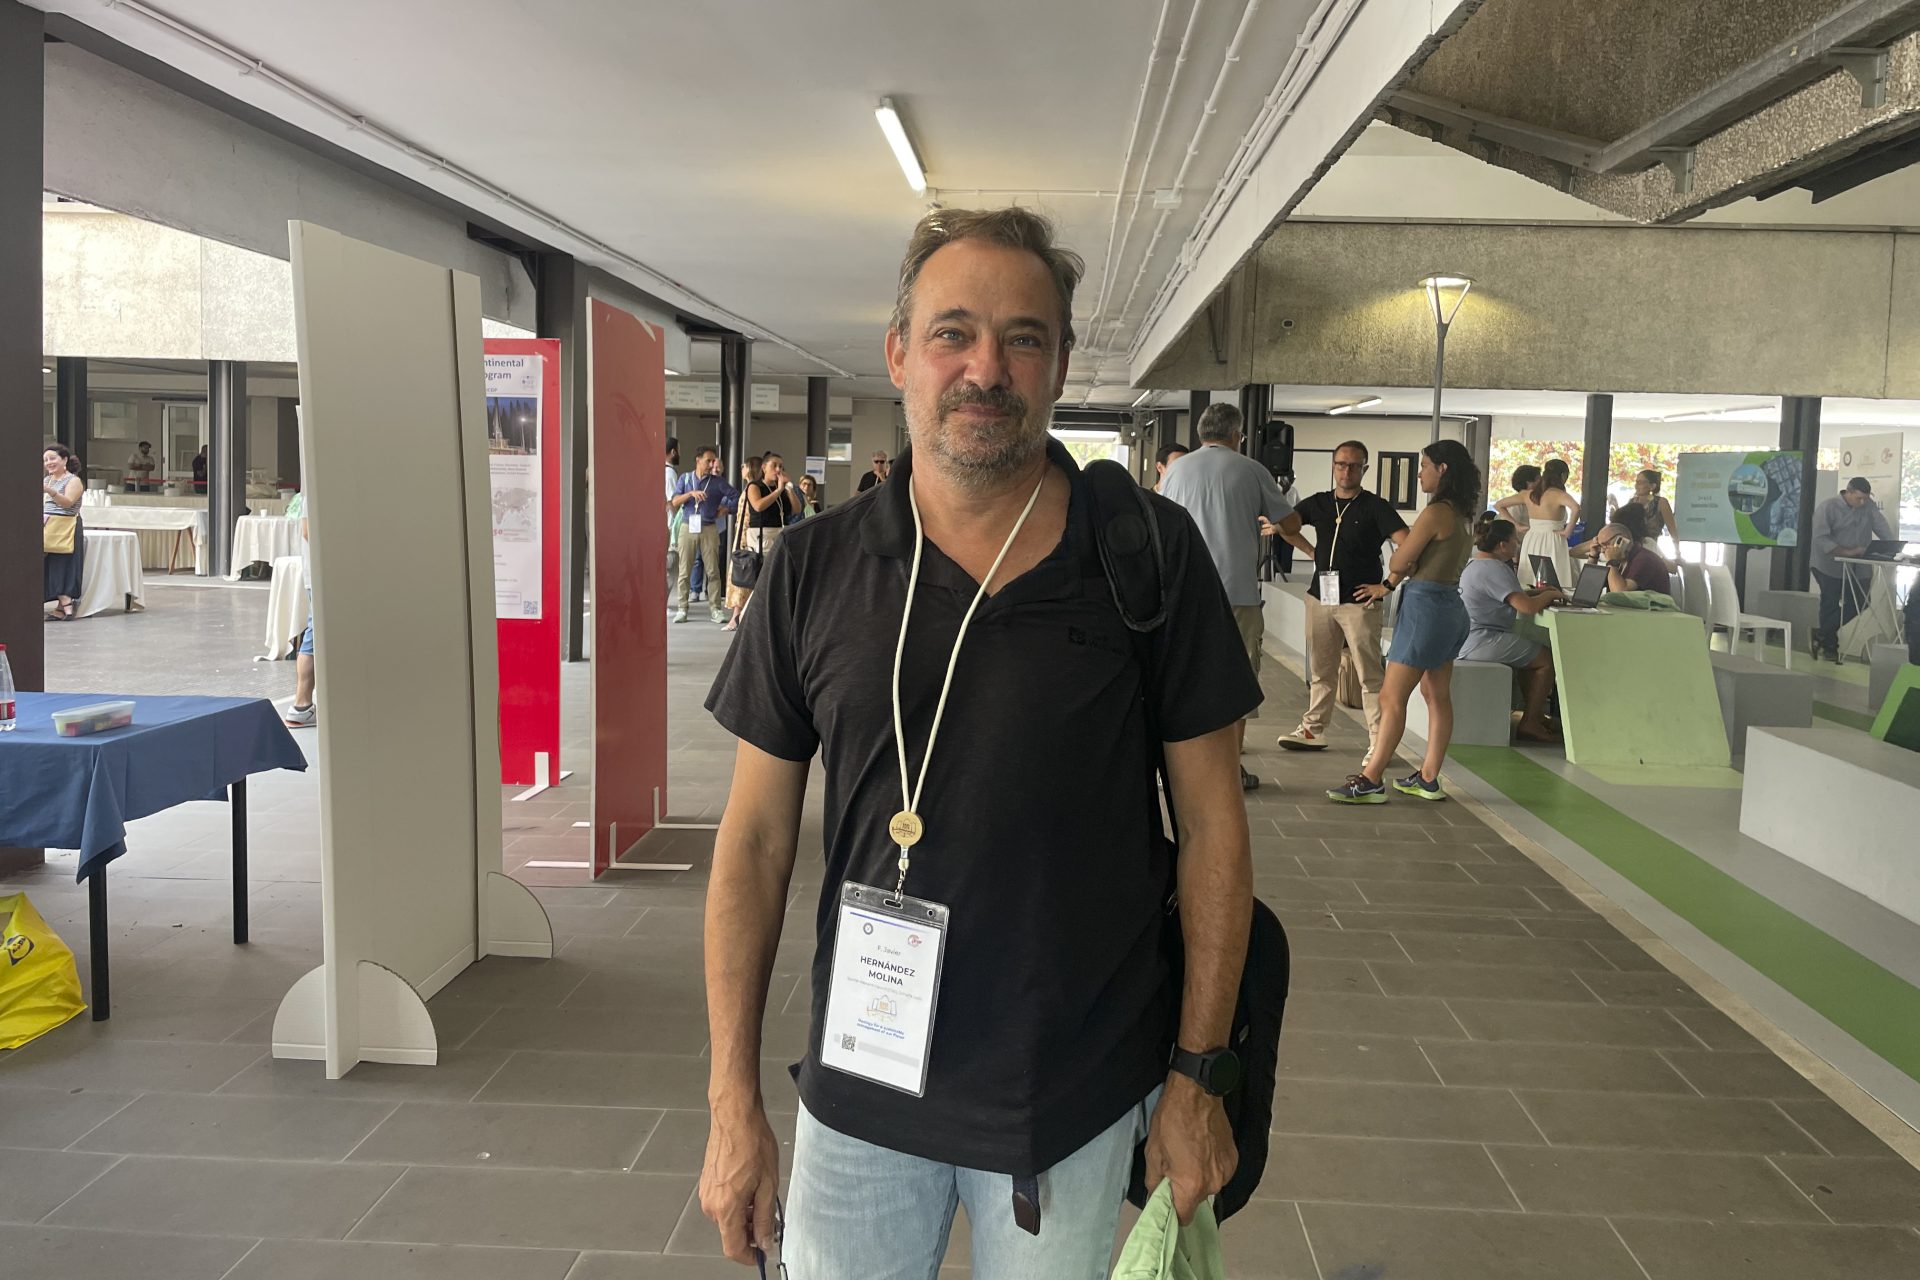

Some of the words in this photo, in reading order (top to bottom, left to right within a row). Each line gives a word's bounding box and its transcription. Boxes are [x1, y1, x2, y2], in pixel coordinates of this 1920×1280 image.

[884, 946, 901, 956] Javier
[860, 955, 916, 977] HERNÁNDEZ
[868, 970, 903, 986] MOLINA
